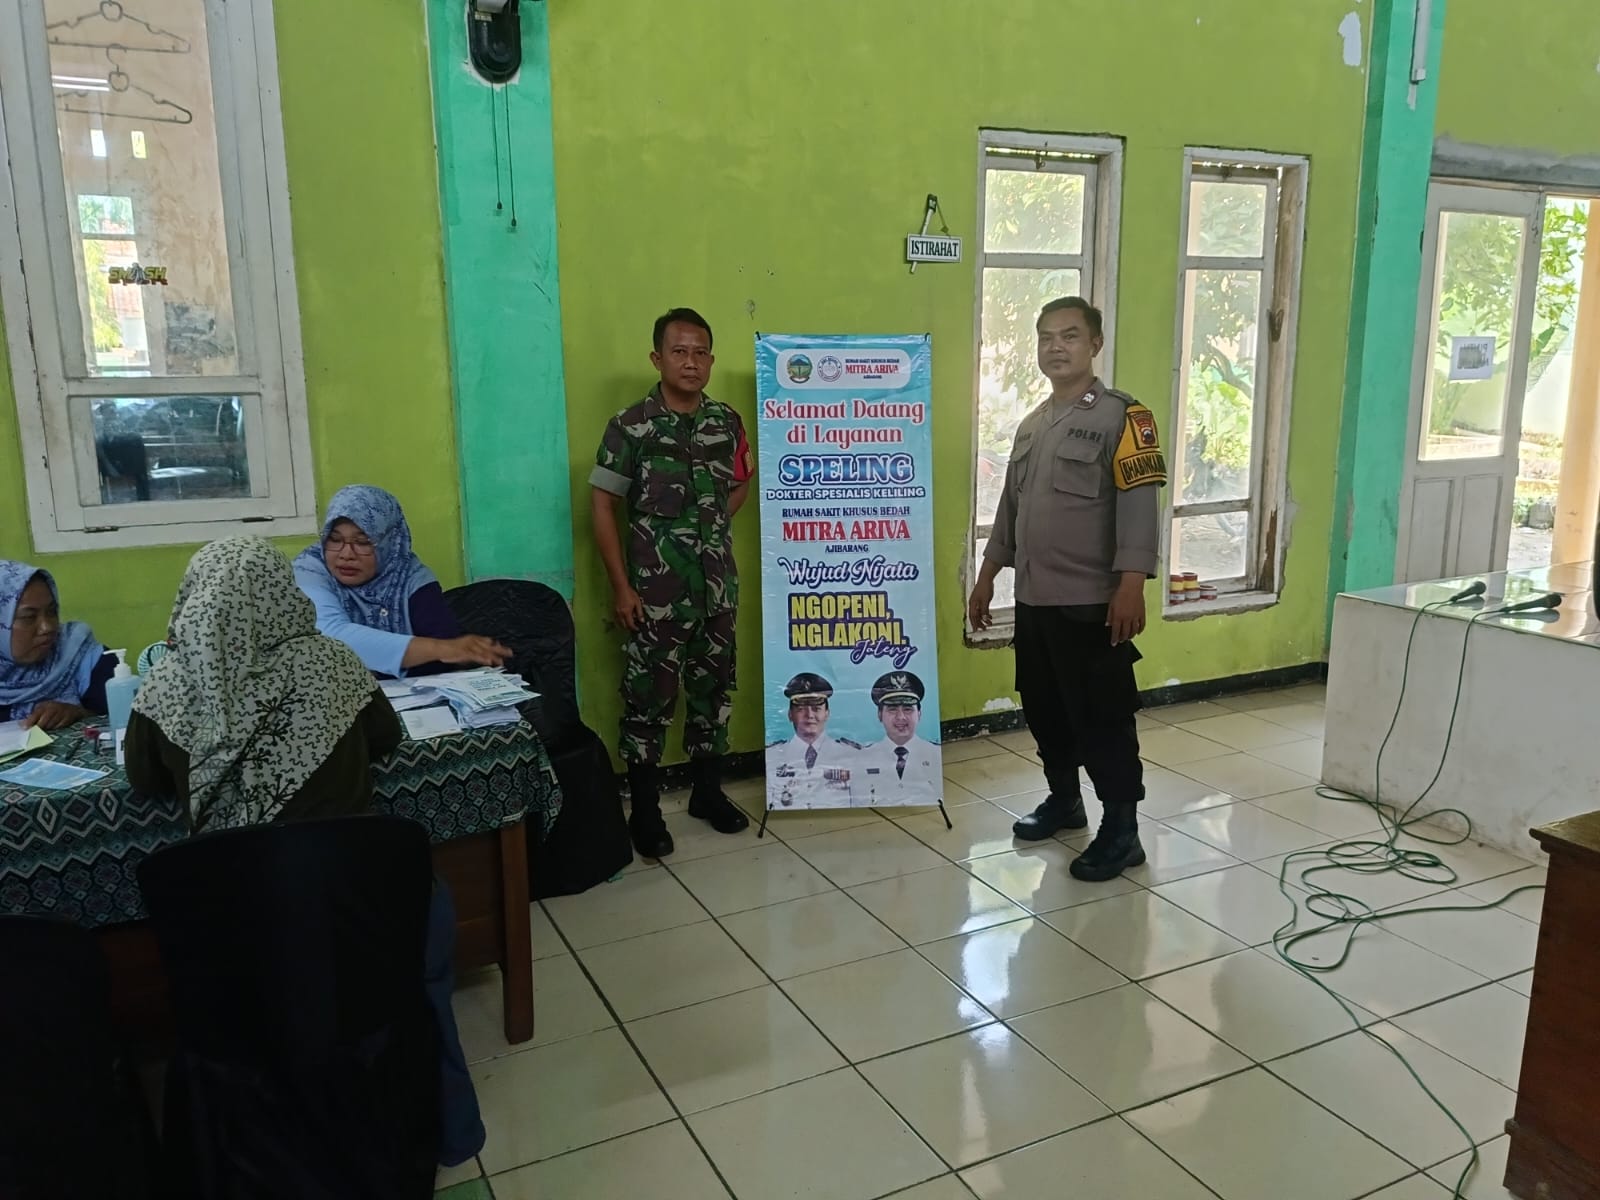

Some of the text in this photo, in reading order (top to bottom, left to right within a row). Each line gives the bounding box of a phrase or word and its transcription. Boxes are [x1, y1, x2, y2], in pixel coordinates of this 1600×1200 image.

[911, 240, 959, 257] ISTIRAHAT
[845, 364, 899, 374] MITRA ARIVA
[764, 399, 925, 424] Selamat Datang
[786, 424, 903, 449] di Layanan
[1067, 427, 1102, 442] POLRI
[779, 453, 914, 486] SPELING
[767, 486, 925, 500] DOKTER SPESIALIS KELILING
[782, 506, 910, 518] RUMAH SAKIT KHUSUS BEDAH
[782, 519, 911, 542] MITRA ARIVA
[825, 544, 869, 553] AJIBARANG
[778, 555, 919, 588] Wujud Nyata
[790, 593, 892, 620] NGOPENI,
[851, 637, 917, 669] Jateng
